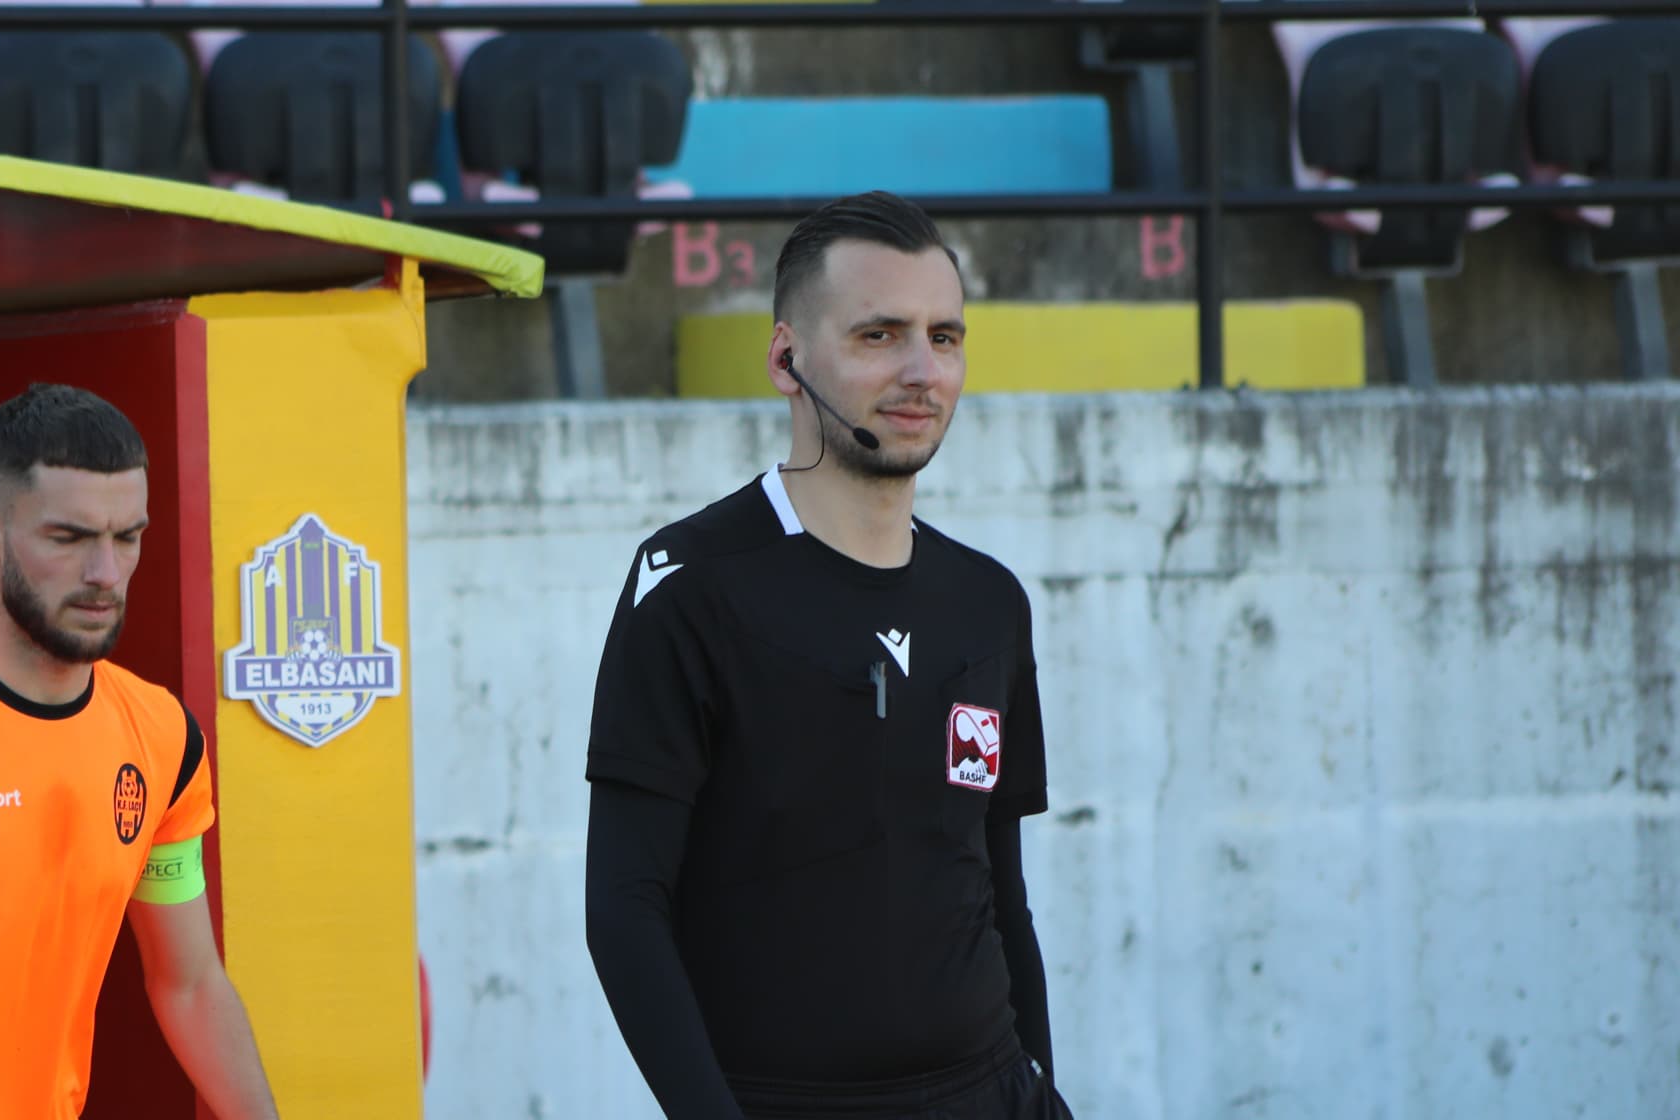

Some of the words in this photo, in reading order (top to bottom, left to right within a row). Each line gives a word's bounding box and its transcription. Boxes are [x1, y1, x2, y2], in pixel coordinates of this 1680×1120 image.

[246, 660, 385, 689] ELBASANI
[300, 703, 332, 715] 1913
[959, 770, 987, 784] BASHF
[142, 861, 184, 877] PECT
